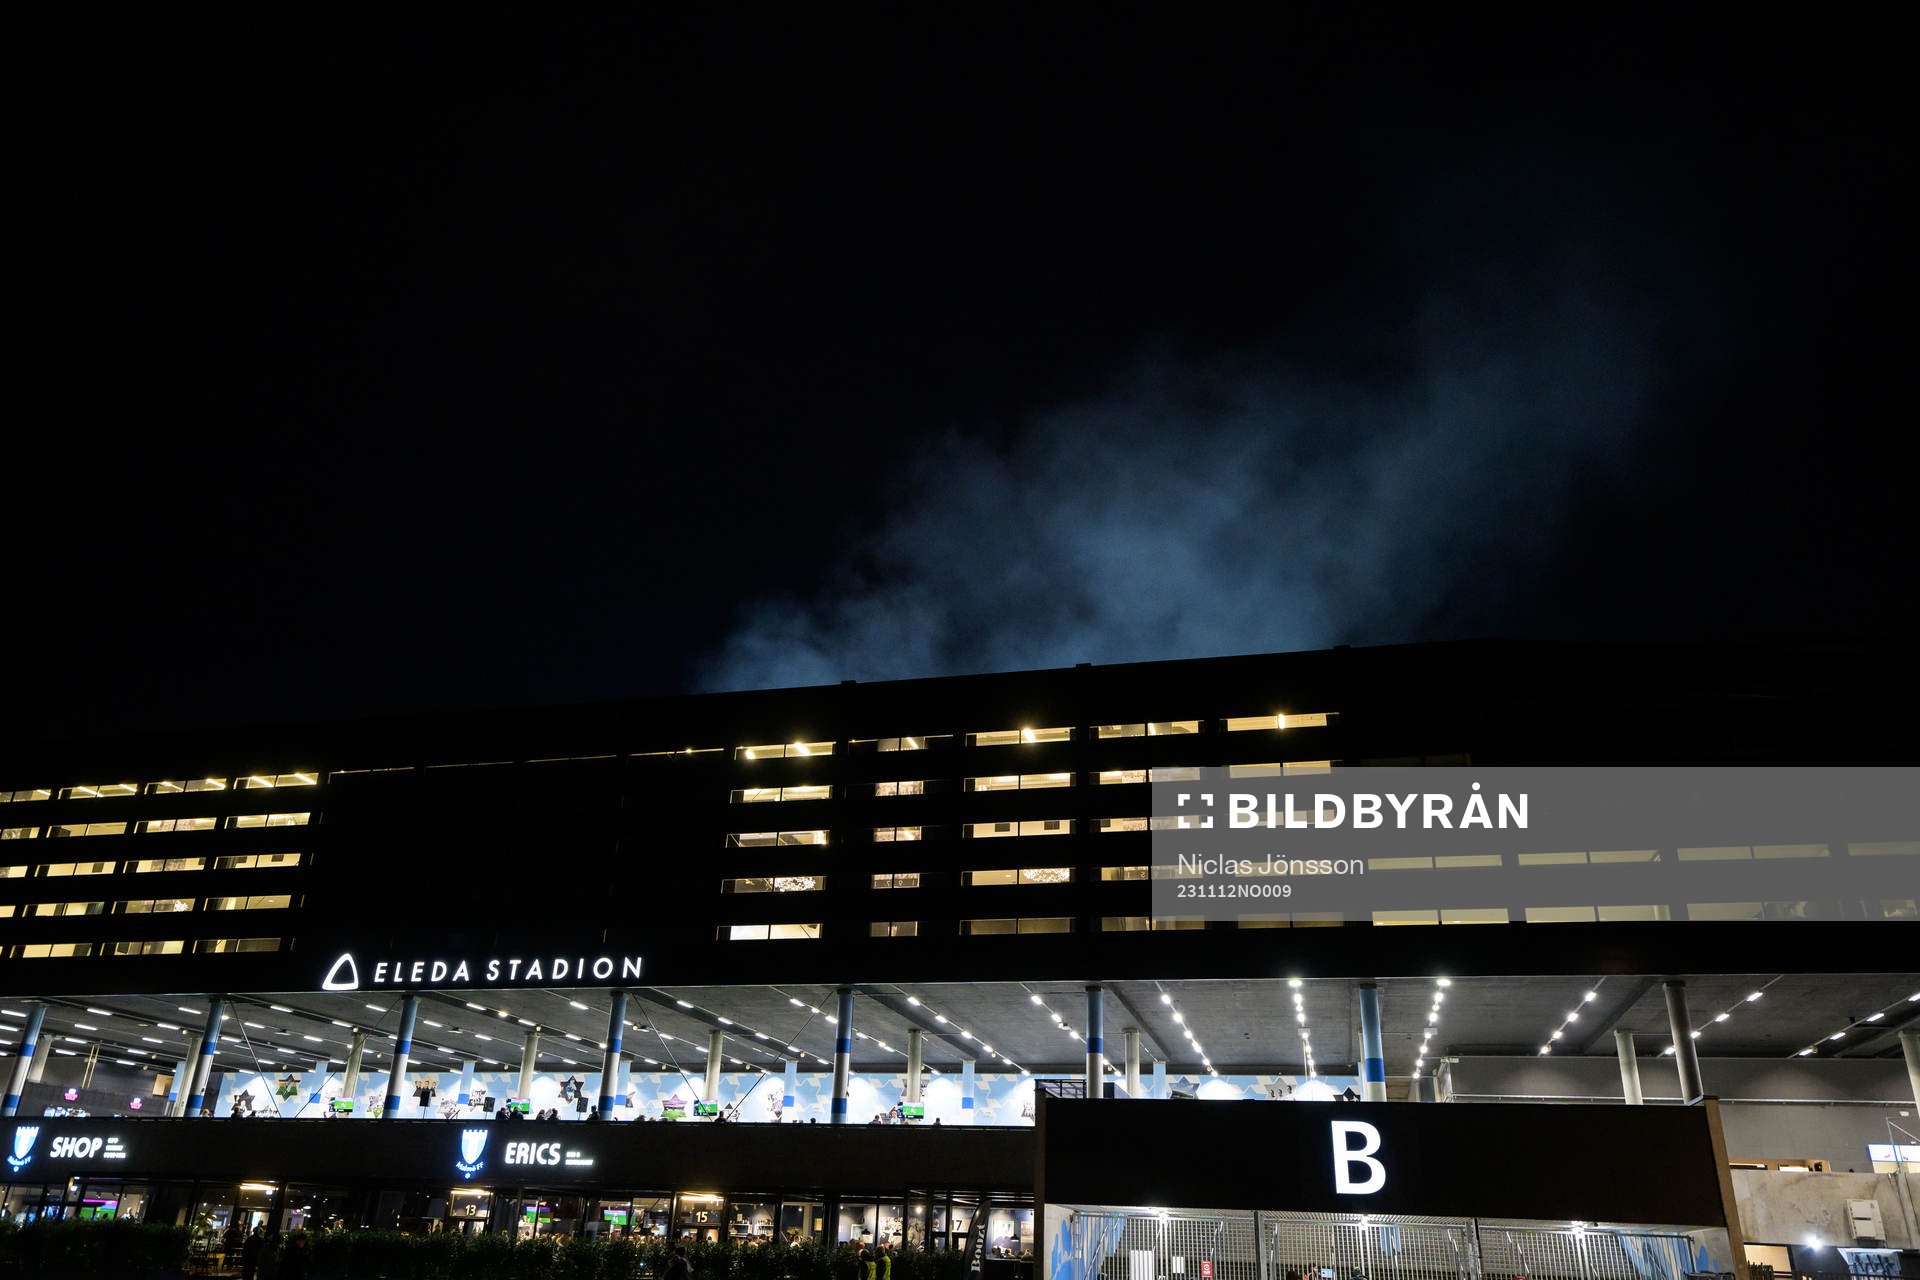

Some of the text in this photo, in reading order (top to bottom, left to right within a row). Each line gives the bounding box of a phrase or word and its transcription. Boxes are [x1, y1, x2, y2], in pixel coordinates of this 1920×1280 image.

[373, 957, 643, 983] ELEDA STADION
[49, 1136, 103, 1158] SHOP
[504, 1141, 561, 1165] ERICS
[1330, 1119, 1387, 1196] B
[464, 1204, 477, 1217] 13
[695, 1211, 708, 1223] 15
